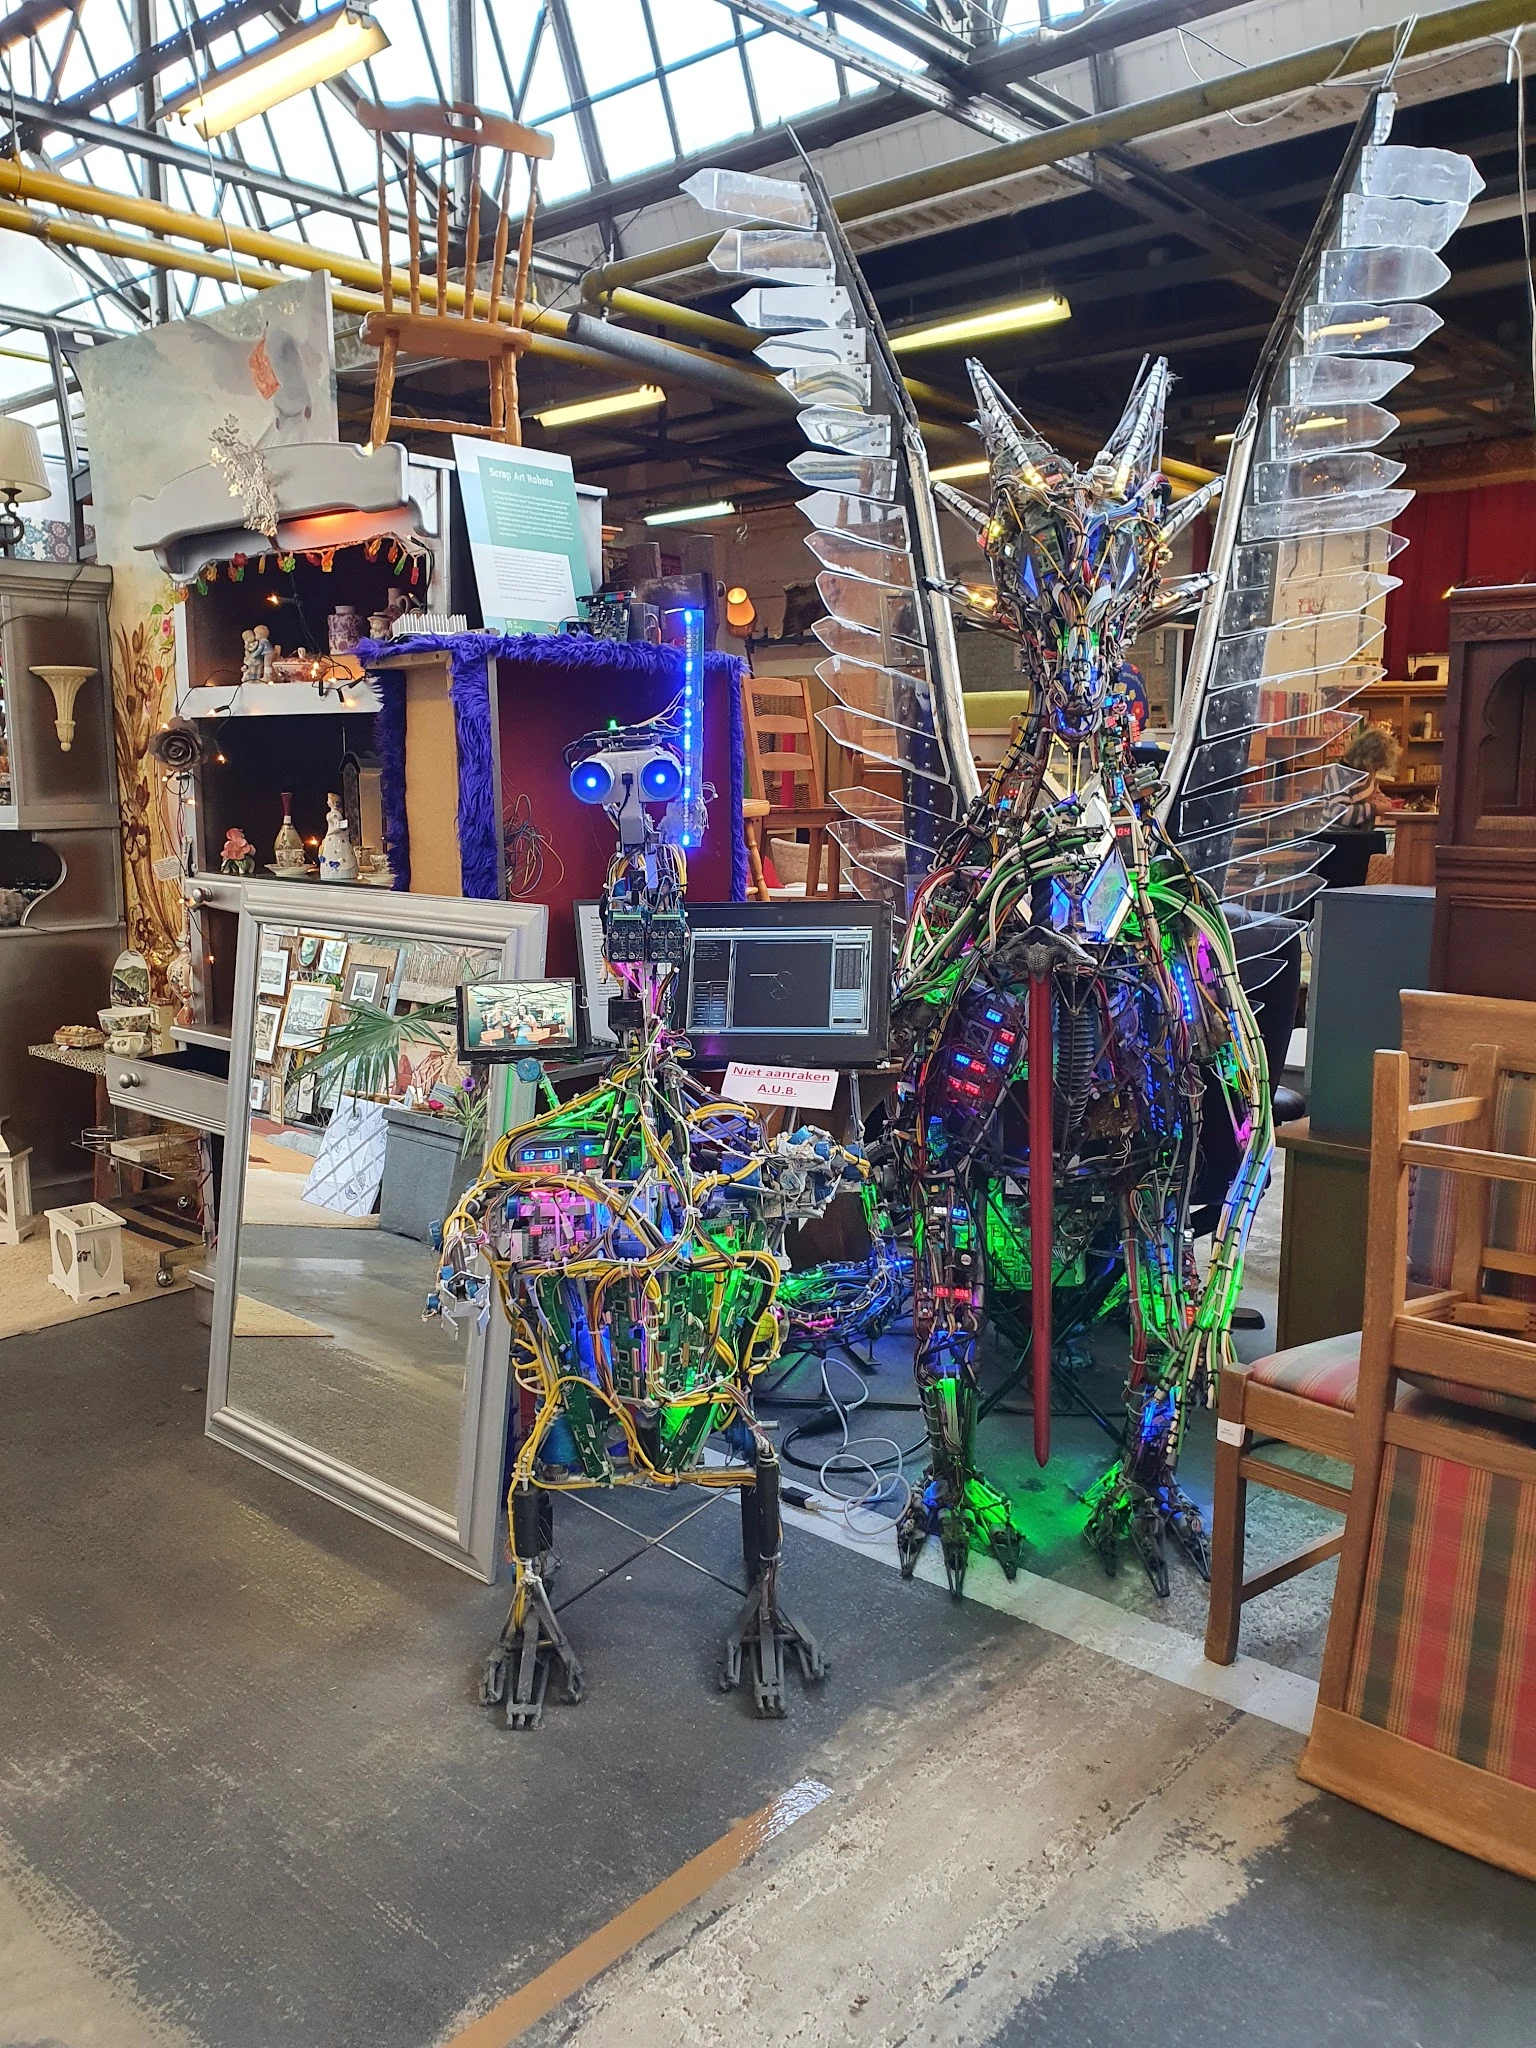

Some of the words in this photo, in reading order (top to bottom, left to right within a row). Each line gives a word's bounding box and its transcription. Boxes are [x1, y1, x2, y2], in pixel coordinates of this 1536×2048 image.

[488, 467, 512, 481] Scrap
[514, 471, 525, 482] Art
[527, 474, 553, 487] Robots
[733, 1066, 763, 1078] Niet
[767, 1069, 830, 1082] aanraken
[757, 1083, 798, 1096] A.U.B.
